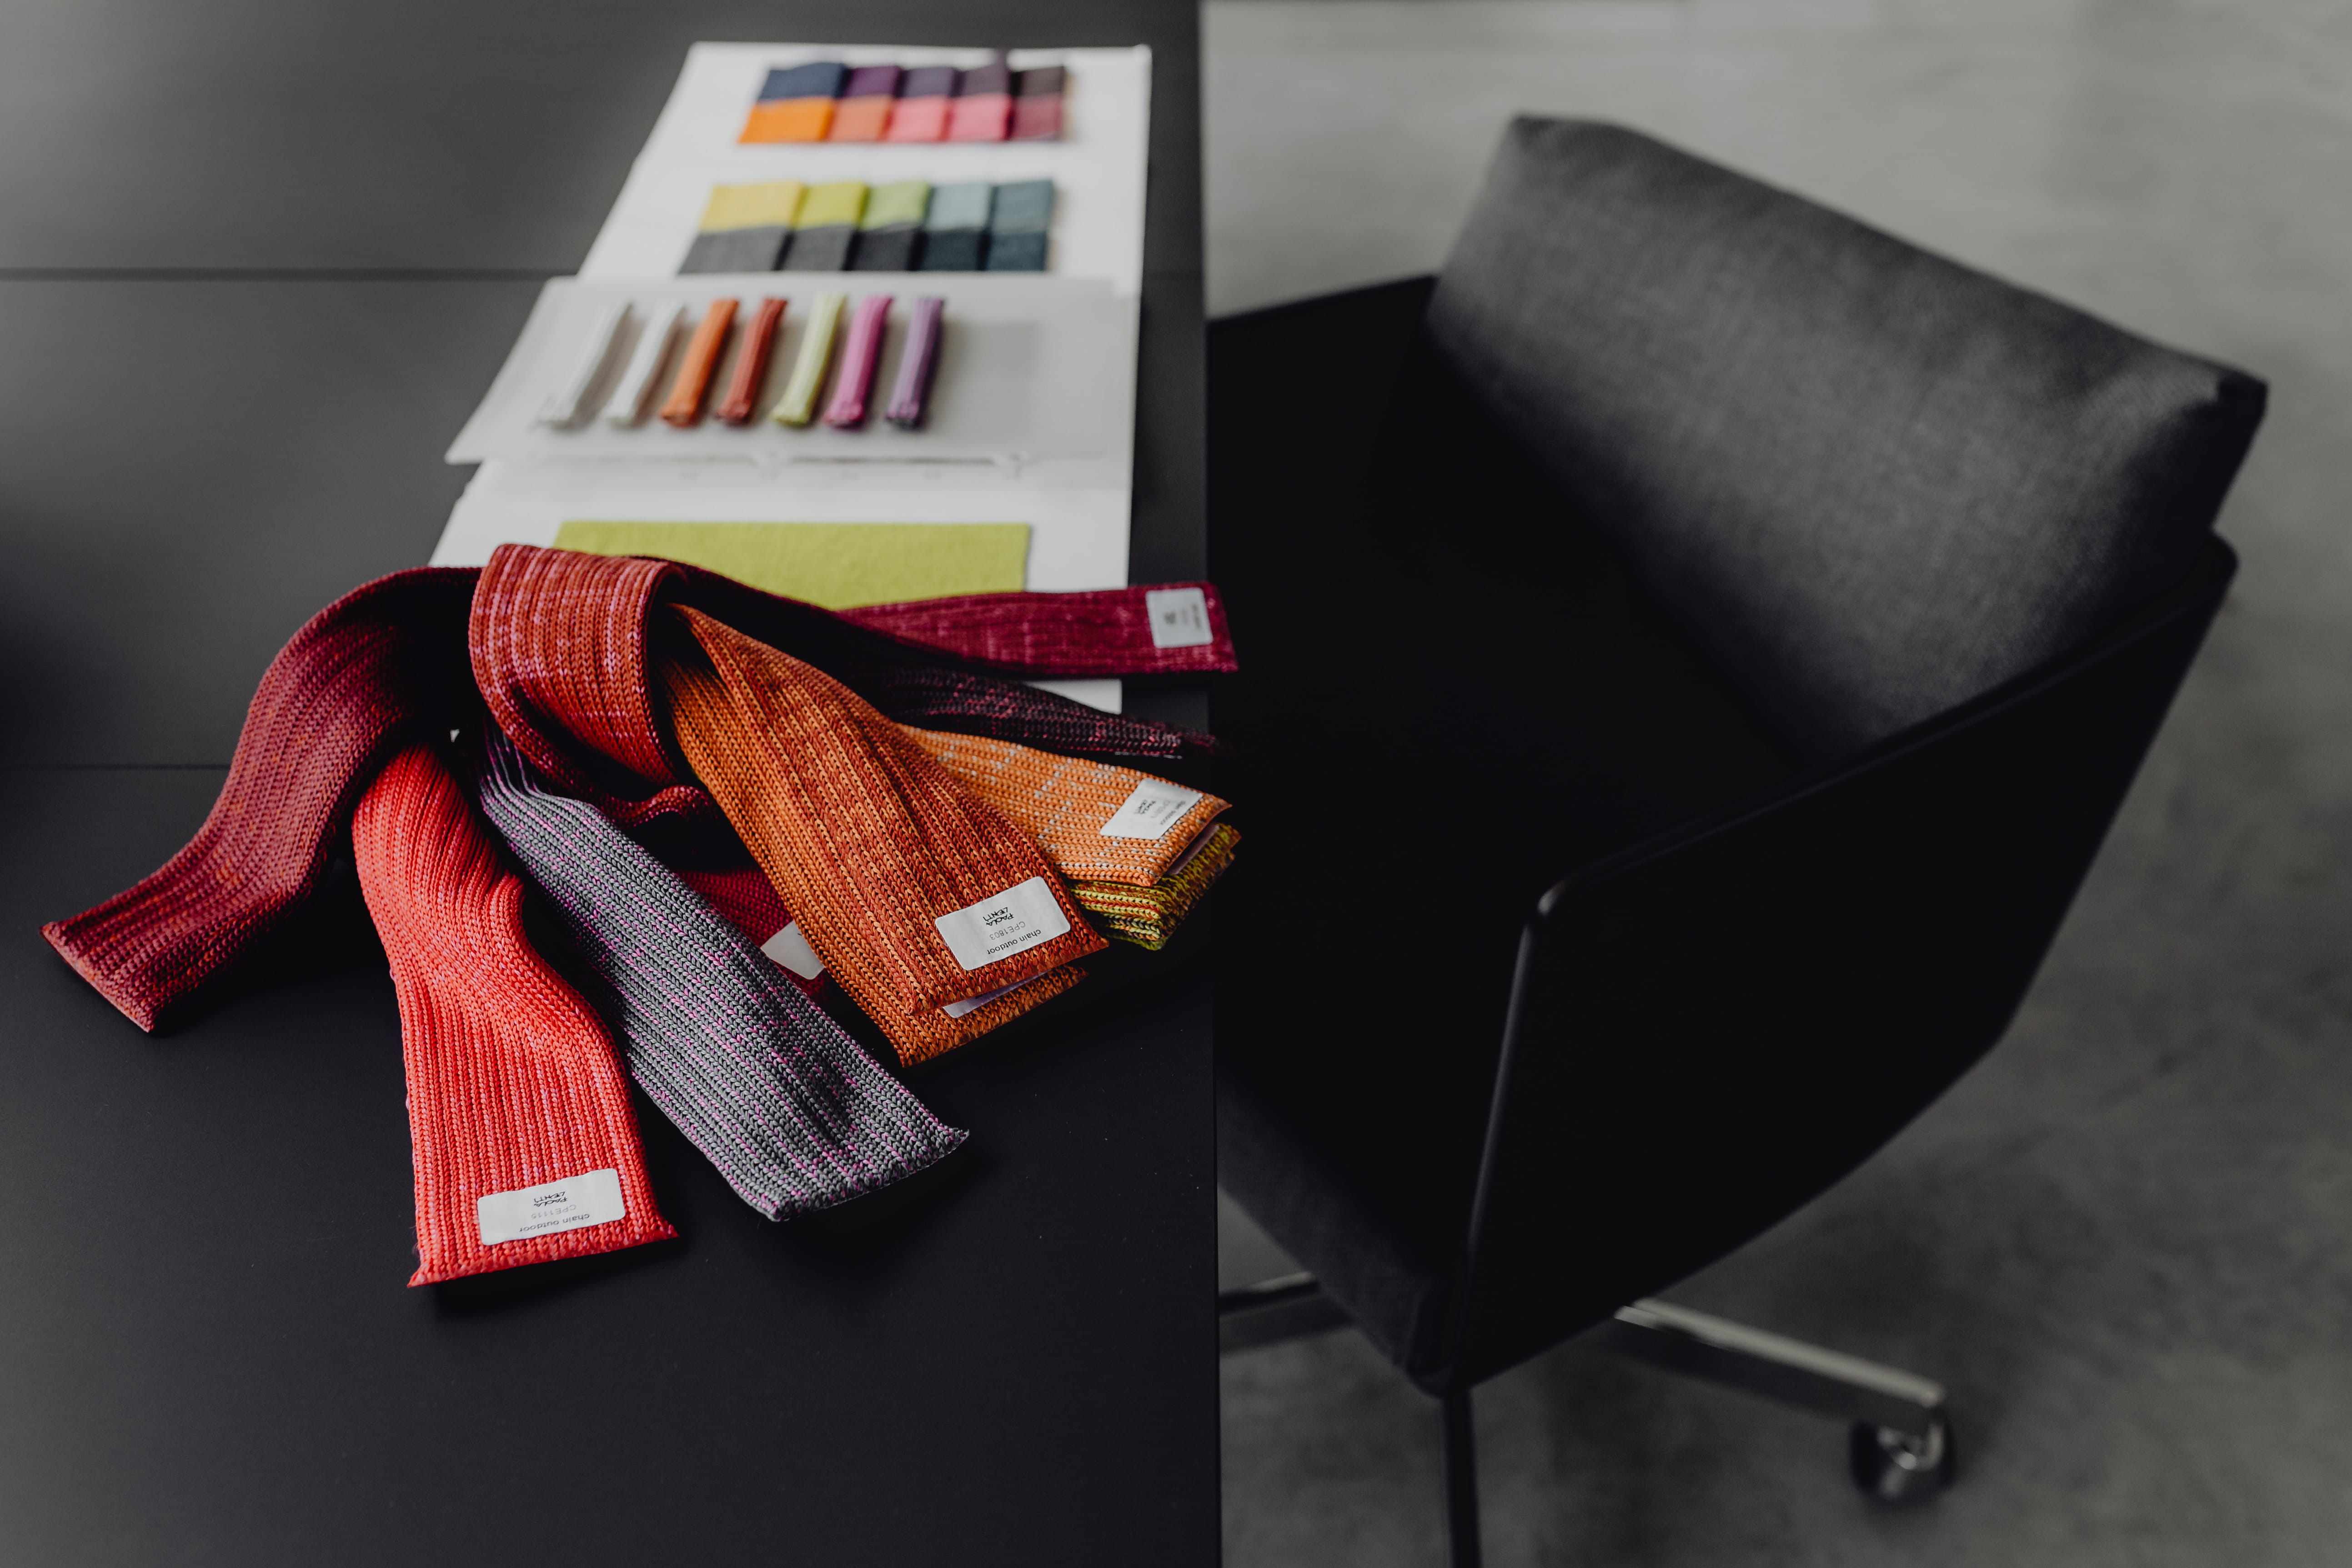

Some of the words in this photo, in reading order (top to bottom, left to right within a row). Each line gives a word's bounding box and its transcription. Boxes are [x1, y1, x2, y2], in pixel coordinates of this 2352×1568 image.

[986, 913, 1014, 926] PAOLA
[989, 921, 1026, 940] CPE1803
[1019, 929, 1041, 942] chain
[987, 939, 1018, 955] outdoor
[531, 1204, 577, 1219] CPE1115
[563, 1214, 590, 1223] chain
[519, 1220, 559, 1232] outdoor
